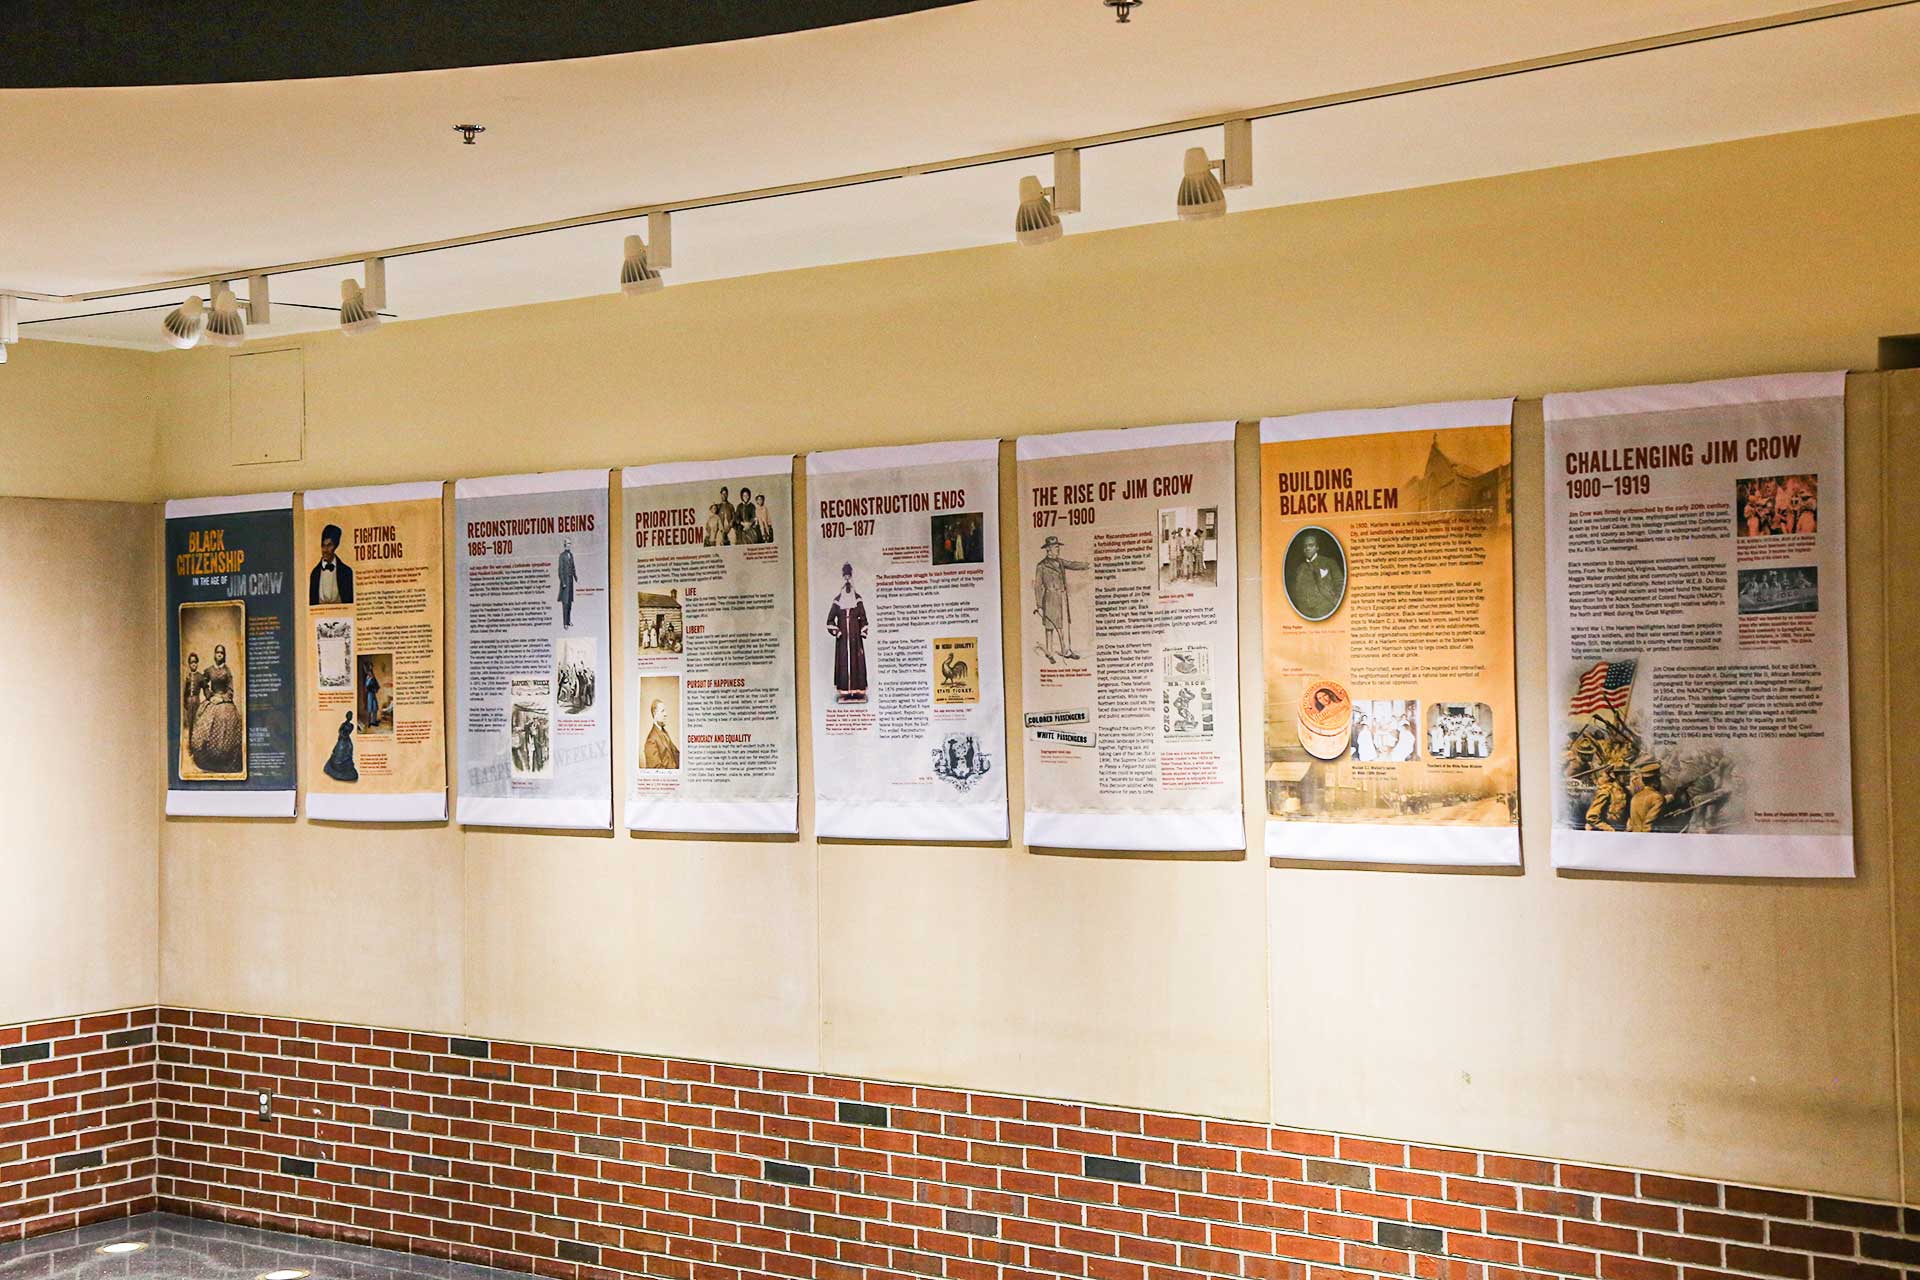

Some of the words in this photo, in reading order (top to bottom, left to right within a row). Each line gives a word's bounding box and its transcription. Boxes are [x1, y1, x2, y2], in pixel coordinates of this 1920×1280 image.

[1566, 443, 1693, 475] CHALLENGING
[1701, 440, 1738, 465] JIM
[1745, 435, 1802, 462] CROW
[1032, 486, 1058, 507] THE
[1064, 483, 1094, 504] RISE
[1099, 481, 1117, 502] OF
[1122, 477, 1148, 500] JIM
[1153, 474, 1193, 497] CROW
[1278, 467, 1353, 494] BUILDING
[821, 492, 929, 519] RECONSTRUCTION
[934, 489, 965, 510] ENDS
[1280, 492, 1328, 516] BLACK
[1334, 487, 1399, 513] HARLEM
[467, 517, 555, 539] RECONSTRUCTION
[559, 514, 595, 533] BEGINS
[635, 508, 696, 530] PRIORITIES
[189, 529, 224, 553] BLACK
[354, 526, 395, 544] FIGHTING
[636, 531, 648, 548] OF
[652, 527, 704, 546] FREEDOM
[177, 549, 245, 576] CITIZENSHIP
[354, 544, 366, 561] TO
[367, 543, 403, 560] BELONG
[192, 577, 200, 586] IN
[200, 577, 210, 586] THE
[211, 576, 220, 585] AGE
[221, 575, 228, 584] OF
[227, 574, 247, 597] JIM
[249, 571, 284, 596] CROW
[714, 679, 745, 688] HAPPINESS
[726, 733, 752, 743] EQUALITY
[1037, 731, 1054, 740] WHITE
